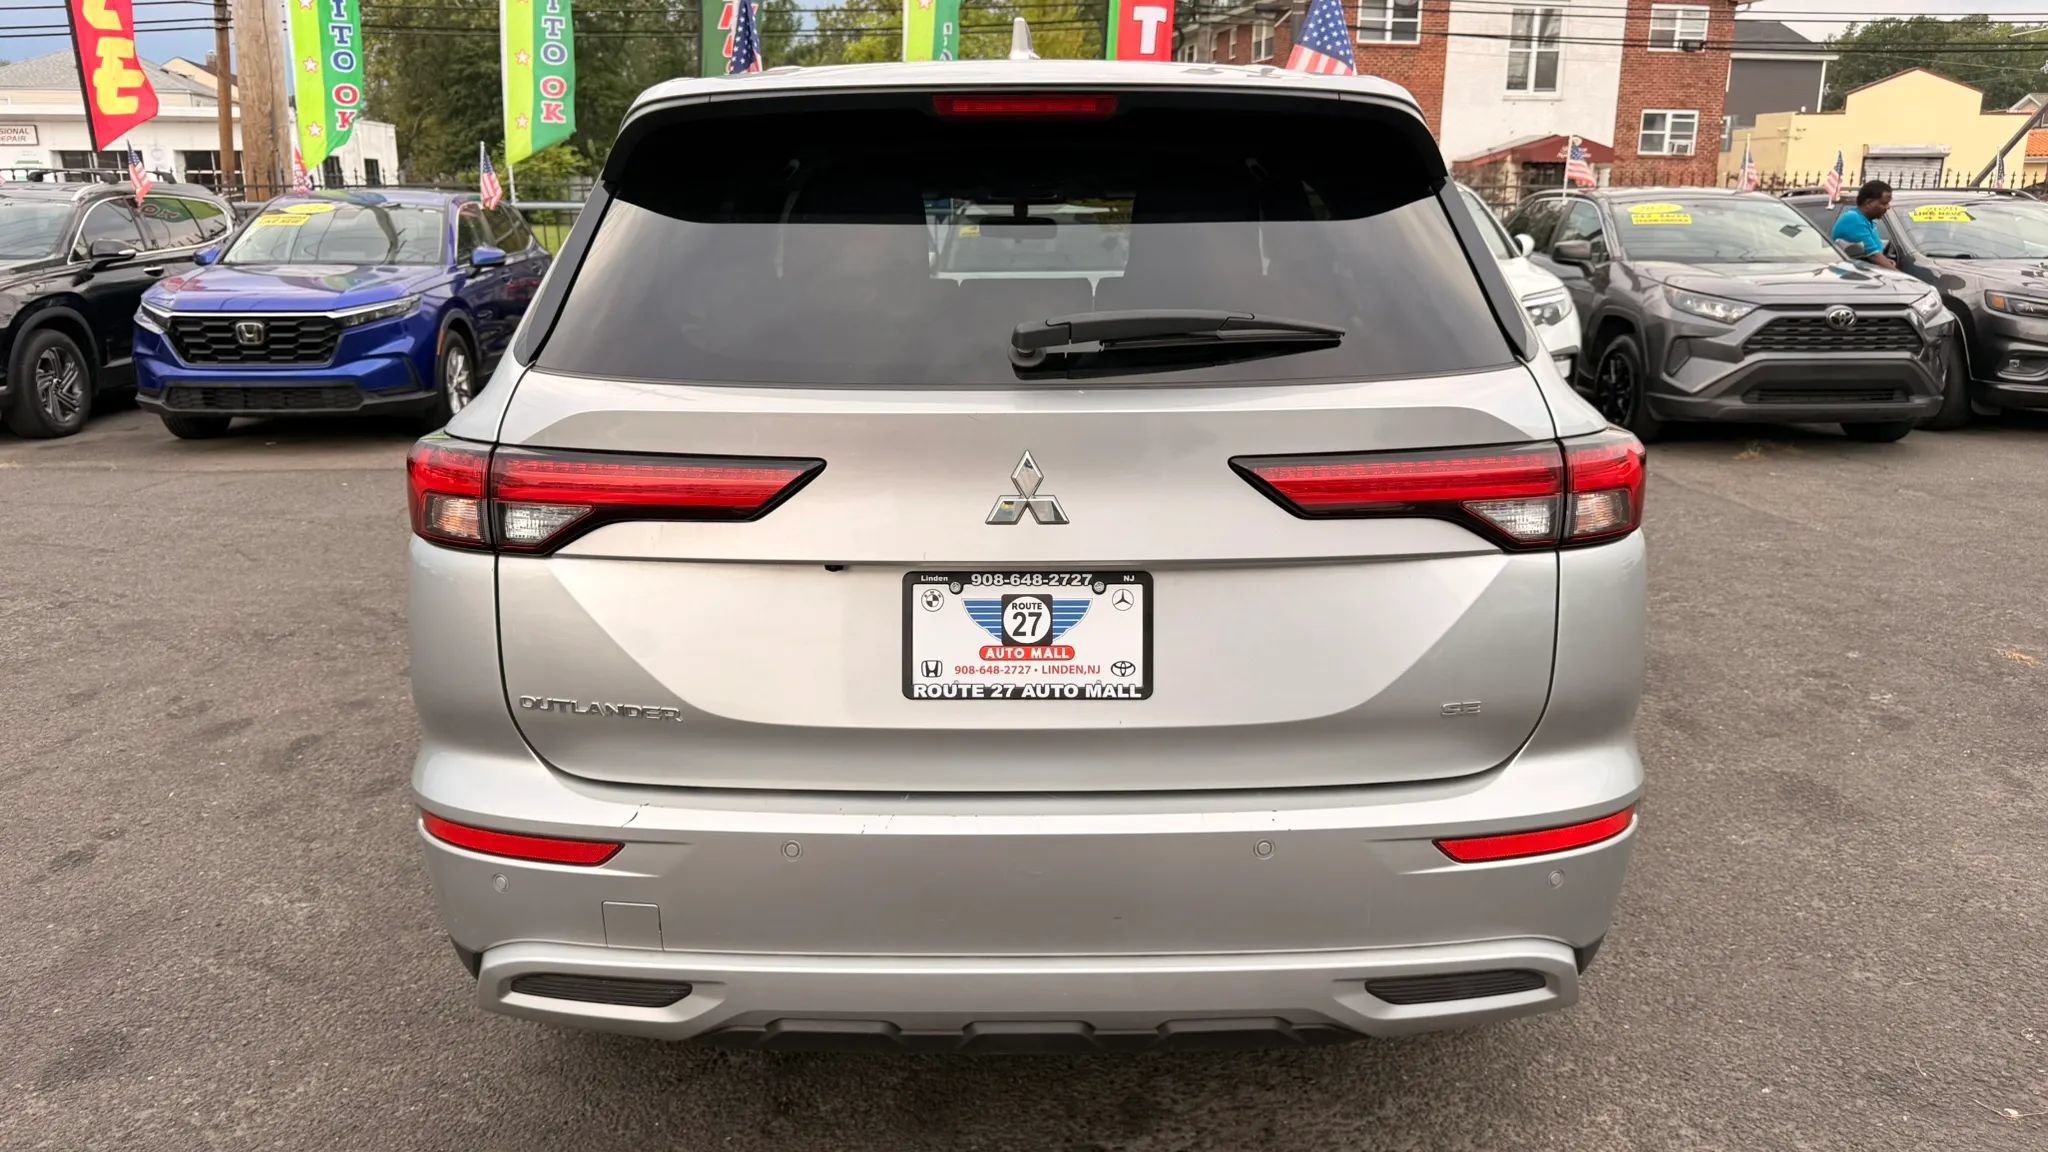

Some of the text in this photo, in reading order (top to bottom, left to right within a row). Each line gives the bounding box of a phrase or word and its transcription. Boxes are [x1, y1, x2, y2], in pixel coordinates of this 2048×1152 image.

[1133, 5, 1168, 55] T
[332, 83, 359, 131] OK
[540, 75, 567, 123] OK
[971, 573, 1092, 586] 908-648-2727
[1011, 602, 1042, 610] ROUTE
[1012, 612, 1042, 637] 27
[985, 647, 1069, 659] AUTO MALL
[954, 665, 1101, 675] 908-648-2727 LINDEN,NJ
[913, 683, 1142, 698] ROUTE 27 AUTO MALL
[519, 695, 683, 723] OUTLANDER
